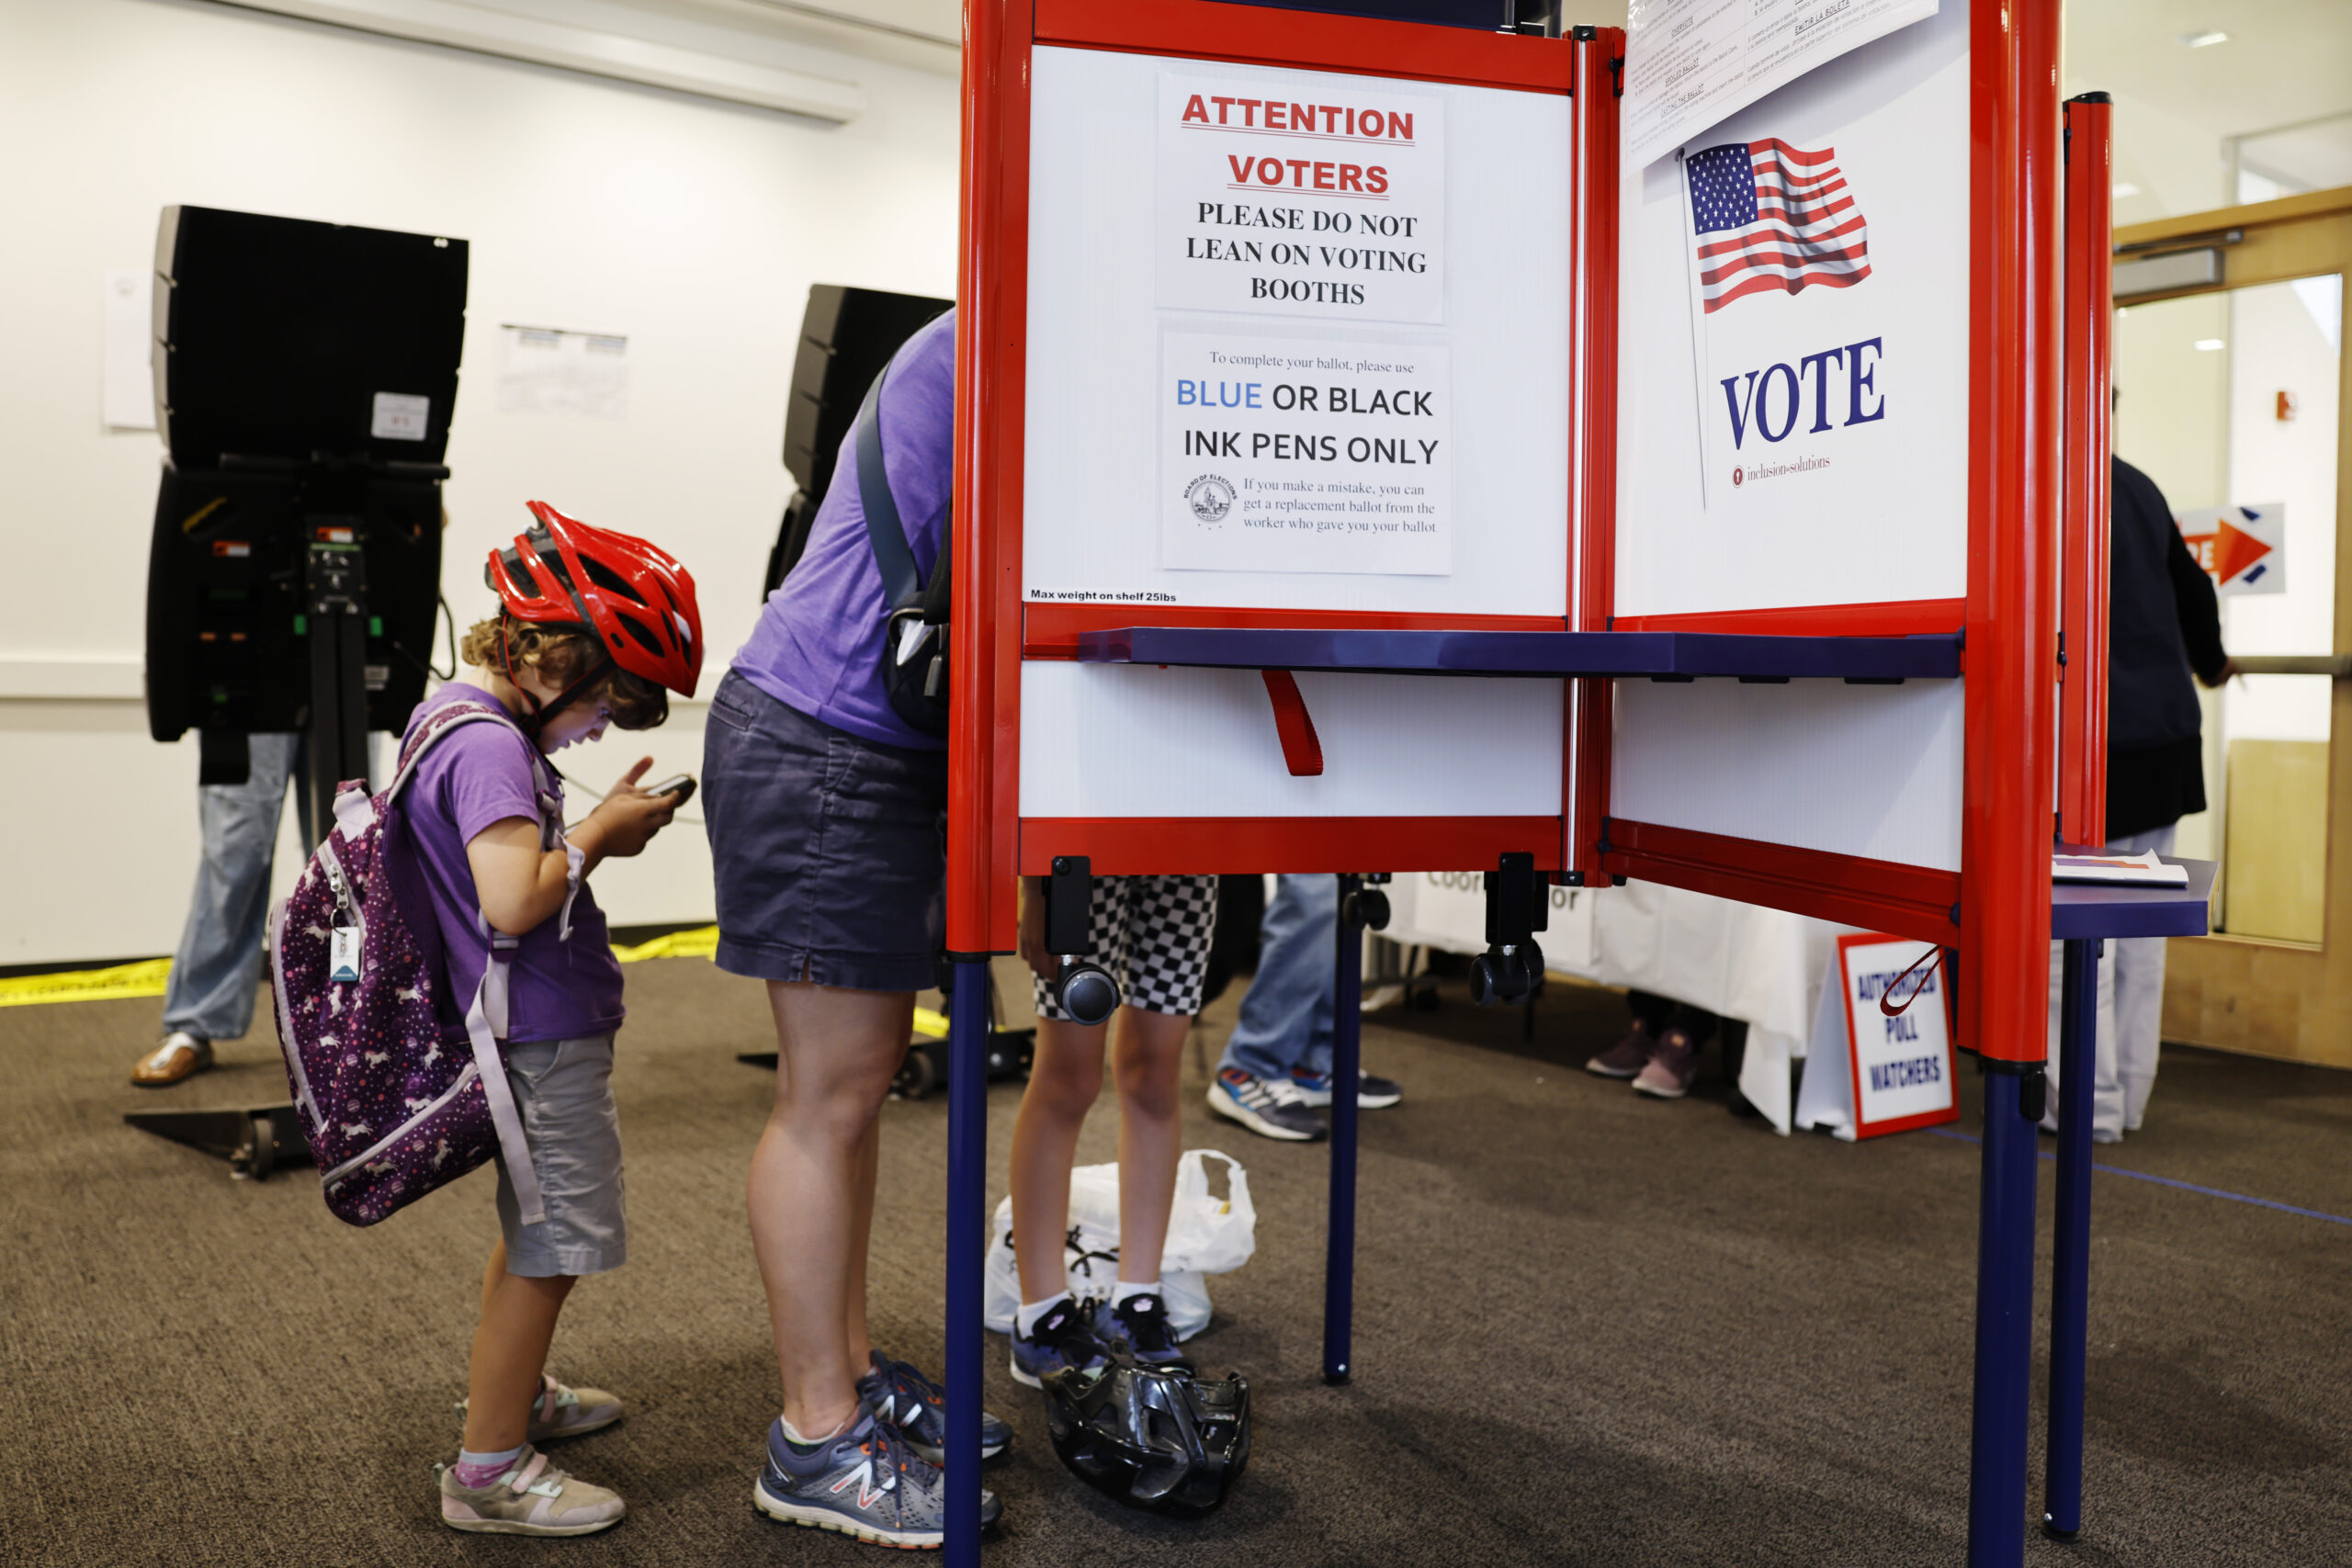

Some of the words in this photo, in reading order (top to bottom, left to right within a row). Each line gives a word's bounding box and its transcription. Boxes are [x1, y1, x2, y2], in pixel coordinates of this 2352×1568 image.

[1795, 17, 1815, 34] EMITIR
[1682, 57, 1699, 74] BALLOT
[1687, 83, 1704, 99] BALLOT
[1182, 94, 1413, 141] ATTENTION
[1227, 154, 1389, 194] VOTERS
[1198, 201, 1305, 230] PLEASE
[1312, 210, 1352, 233] DO
[1360, 214, 1418, 238] NOT
[1186, 237, 1262, 263] LEAN
[1271, 243, 1311, 265] ON
[1319, 246, 1428, 274] VOTING
[1250, 277, 1365, 305] BOOTHS
[1209, 352, 1227, 364] To
[1229, 354, 1283, 368] complete
[1286, 357, 1314, 369] your
[1317, 357, 1352, 371] ballot,
[1356, 360, 1392, 374] please
[1395, 364, 1414, 373] use
[1177, 379, 1262, 409] BLUE
[1272, 384, 1318, 412] OR
[1329, 387, 1433, 416] BLACK
[1720, 336, 1884, 450] VOTE
[1185, 430, 1242, 457] INK
[1252, 433, 1338, 461] PENS
[1347, 436, 1439, 465] ONLY
[1183, 478, 1199, 499] BOARD
[1209, 474, 1238, 500] ELECTIONS
[1243, 478, 1254, 490] If
[1258, 482, 1279, 493] you
[1283, 480, 1314, 491] make
[1317, 484, 1324, 492] a
[1328, 481, 1376, 494] mistake,
[1379, 486, 1401, 497] you
[1404, 486, 1425, 495] can
[1243, 500, 1261, 511] get
[1275, 500, 1345, 513] replacement
[1350, 501, 1382, 513] ballot
[1385, 502, 1414, 513] from
[1417, 502, 1435, 514] the
[1243, 517, 1285, 528] worker
[1288, 518, 1314, 529] who
[1317, 522, 1344, 533] gave
[1347, 523, 1369, 534] you
[1373, 524, 1400, 535] your
[1403, 521, 1436, 533] ballot
[1031, 590, 1055, 599] Max
[1057, 591, 1097, 601] weight
[1115, 592, 1144, 601] shelf
[1146, 592, 1177, 602] 25lbs
[1858, 968, 1936, 999] AUTHORIZED
[1885, 1015, 1918, 1043] POLL
[1870, 1055, 1941, 1091] WATCHERS
